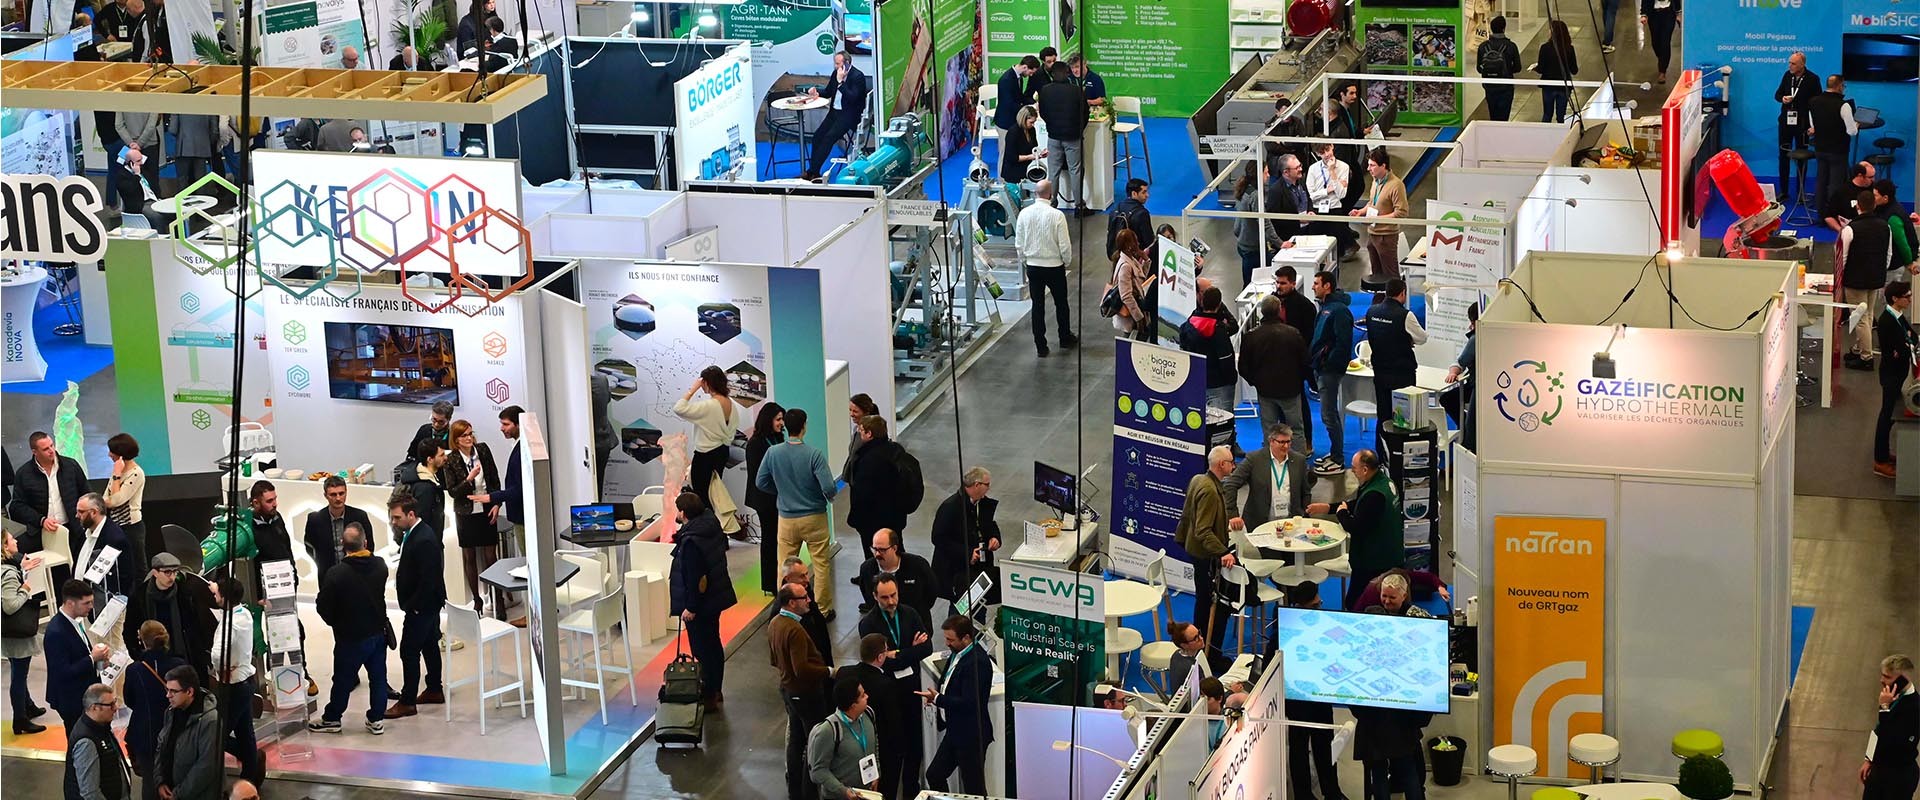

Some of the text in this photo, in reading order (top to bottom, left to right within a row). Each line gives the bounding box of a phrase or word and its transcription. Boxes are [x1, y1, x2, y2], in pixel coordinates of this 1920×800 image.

[688, 62, 742, 112] BÖRGER
[628, 271, 720, 283] ILS NOUS FONT CONFIANCE
[280, 293, 291, 305] LE
[352, 298, 399, 313] FRANÇAIS
[401, 302, 414, 313] DE
[4, 312, 14, 363] Kanadevia
[14, 330, 23, 362] INOVA
[1577, 378, 1744, 403] GAZÉIFICATION
[1576, 397, 1744, 419] HYDROTHERMALE
[1577, 412, 1624, 421] VALORISER
[1626, 414, 1641, 422] LES
[1686, 417, 1744, 428] ORGANIQUES
[1507, 587, 1590, 599] Nouveau nom
[1518, 600, 1579, 614] de GRTgaz
[1010, 616, 1061, 633] HTG on an
[1011, 628, 1056, 646] Industrial
[1058, 637, 1084, 651] Scae
[1011, 642, 1034, 654] Now
[1036, 648, 1042, 656] a
